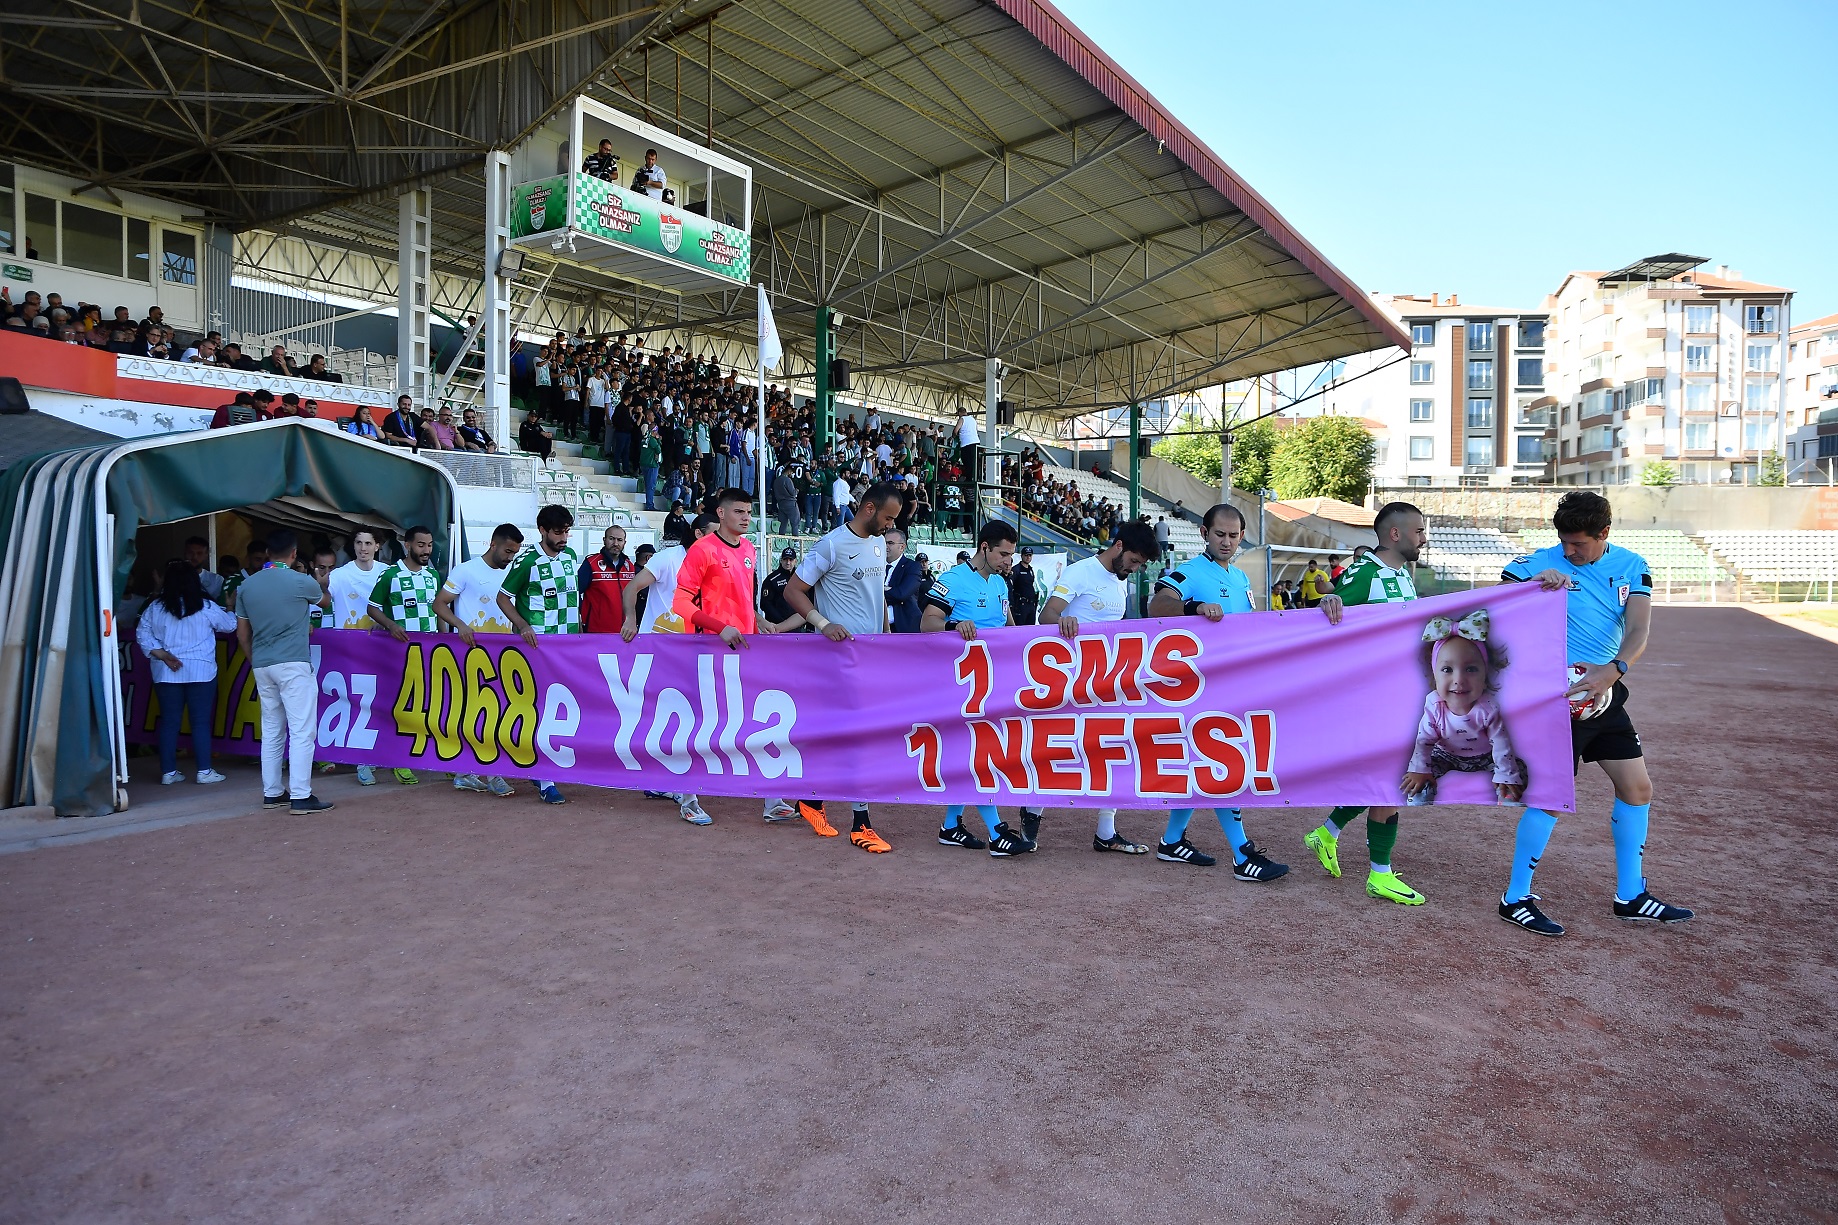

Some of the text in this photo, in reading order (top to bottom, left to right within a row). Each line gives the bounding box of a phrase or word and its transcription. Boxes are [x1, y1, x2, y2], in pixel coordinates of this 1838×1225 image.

[591, 202, 640, 226] OLMAZSANIZ
[699, 239, 740, 259] OLMAZSANIZ
[597, 653, 804, 779] Yolla
[954, 629, 1206, 717] 1 SMS
[904, 709, 1281, 798] 1 NEFES!
